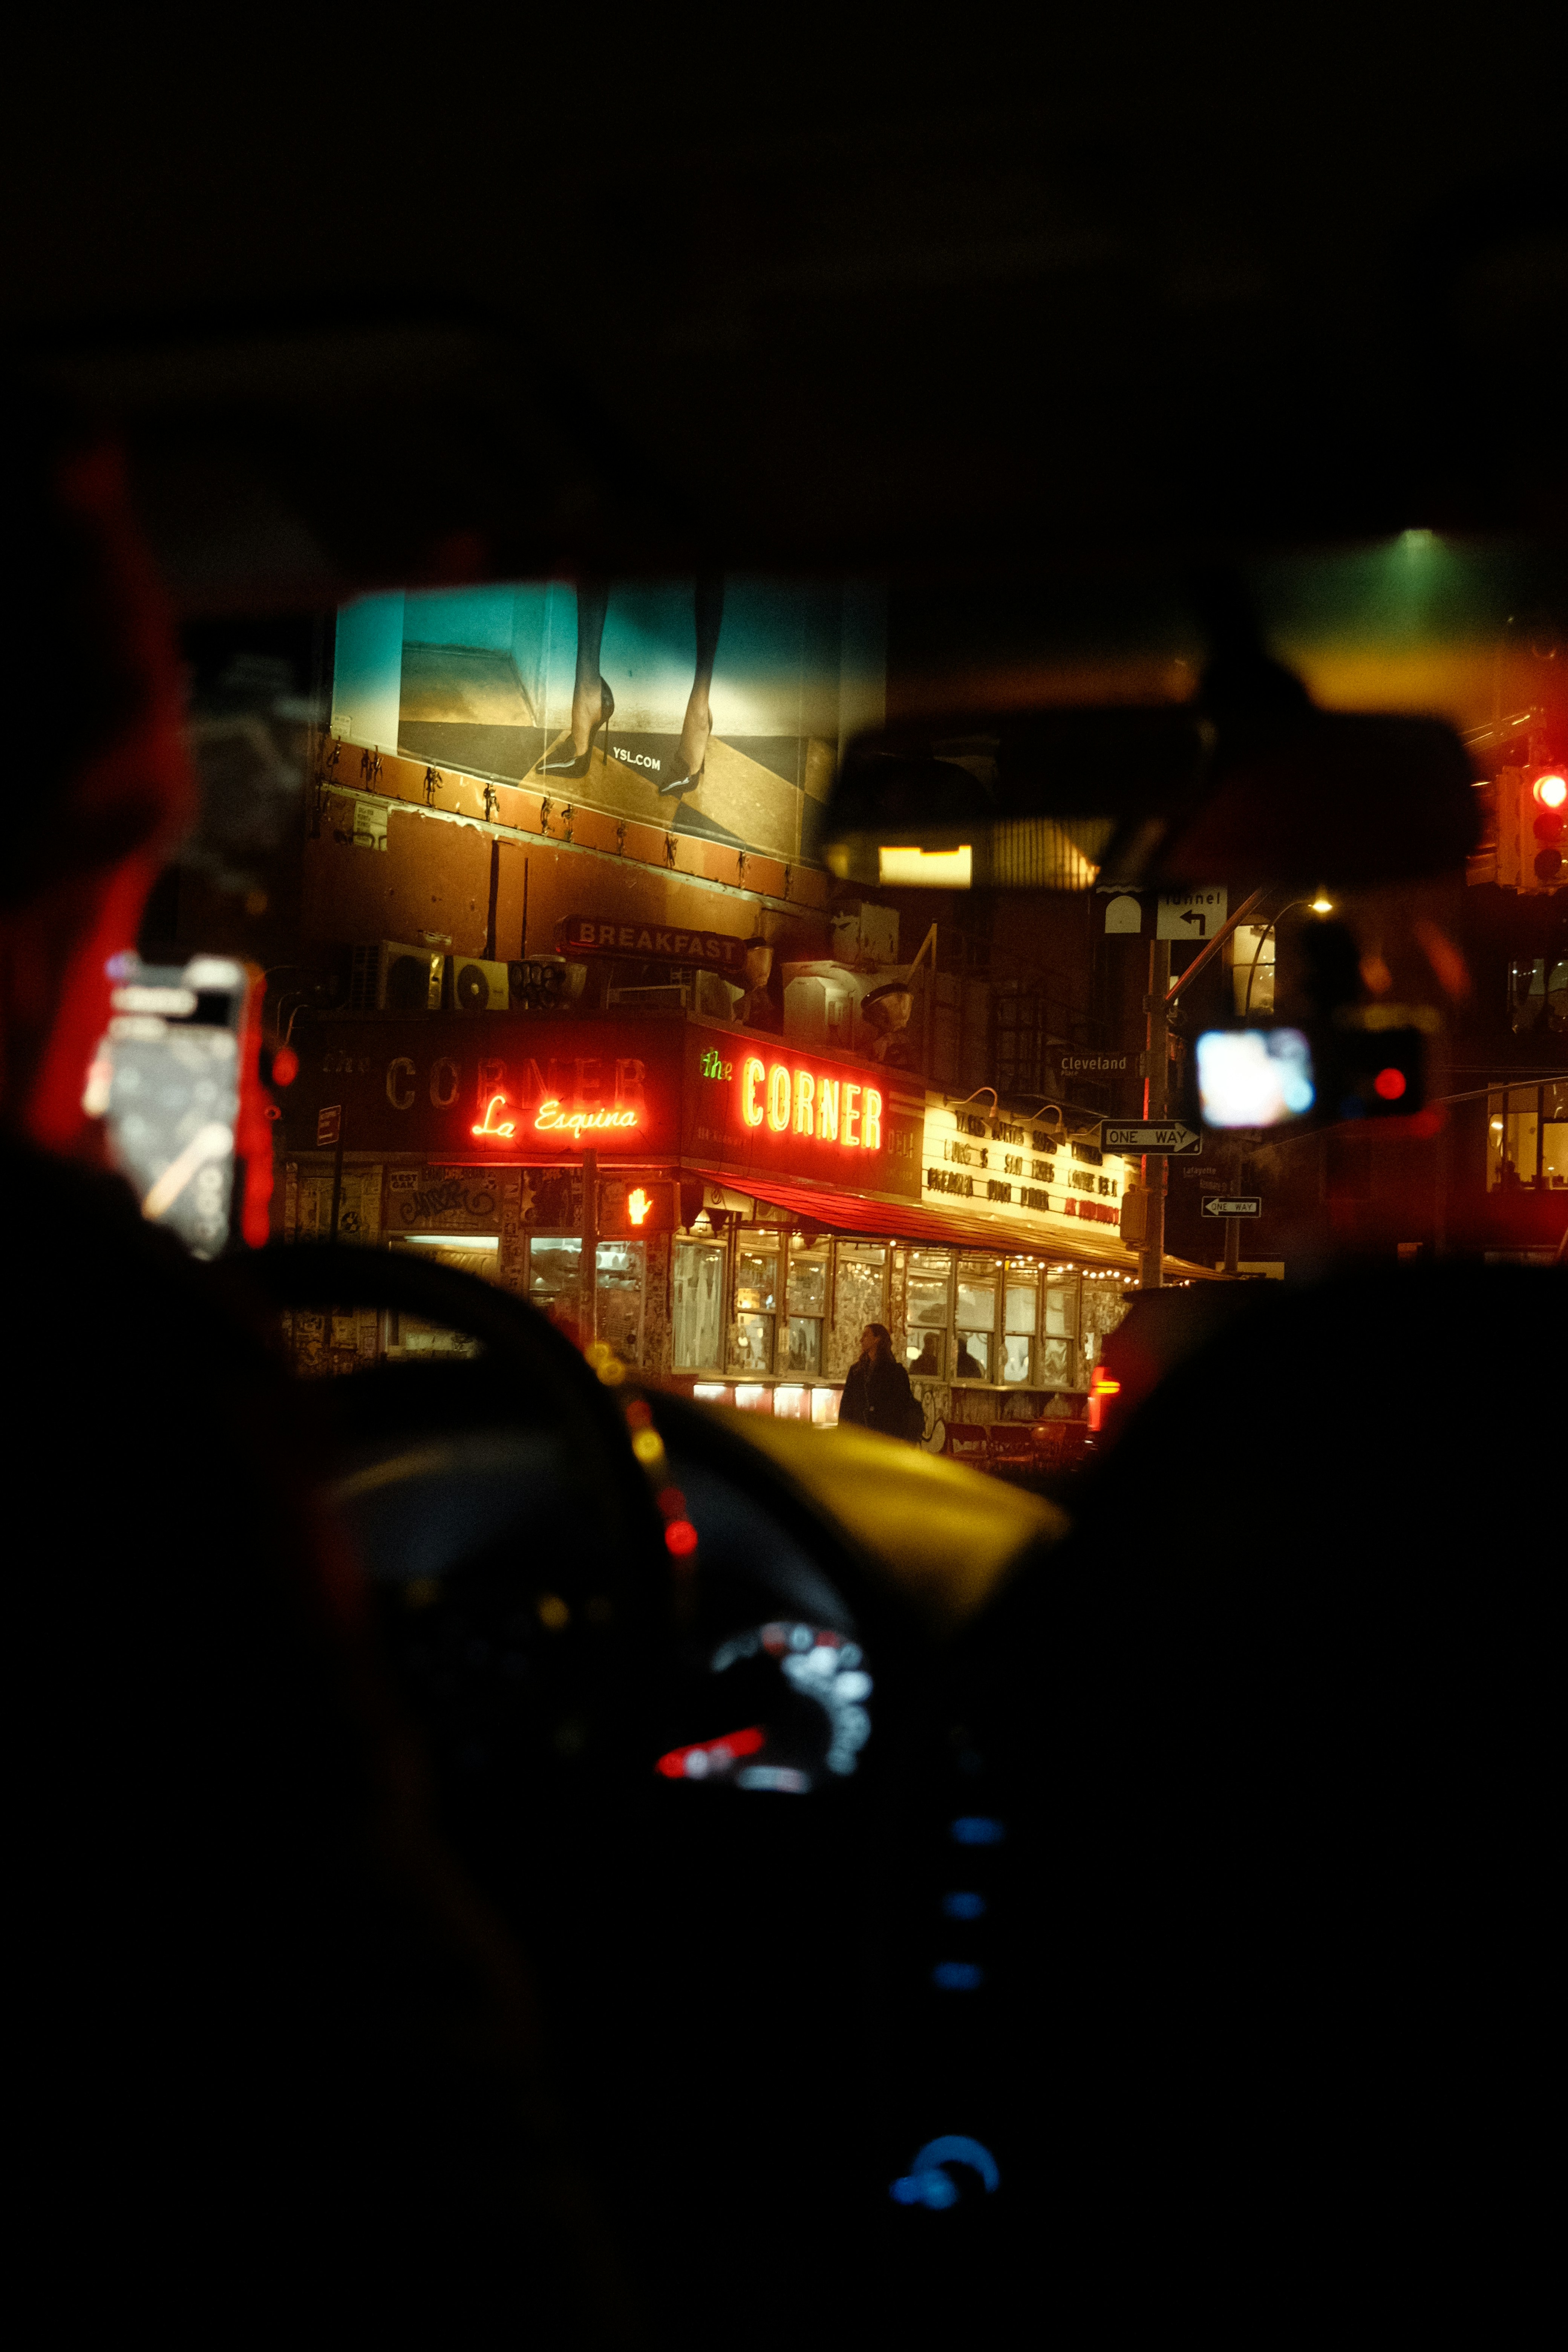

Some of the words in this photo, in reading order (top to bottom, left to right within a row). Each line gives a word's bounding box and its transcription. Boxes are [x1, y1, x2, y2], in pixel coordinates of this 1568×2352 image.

[613, 747, 660, 771] YSL.COM
[579, 922, 736, 961] BREAKFAST
[1061, 1057, 1127, 1070] Cleveland
[386, 1057, 646, 1110] CORNER
[700, 1048, 732, 1081] the
[743, 1057, 882, 1149] CORNER
[472, 1096, 515, 1138] La
[534, 1100, 638, 1139] Esquina
[1110, 1131, 1138, 1143] ONE
[1156, 1131, 1188, 1143] WAY
[1211, 1202, 1228, 1211] ONE
[1235, 1202, 1254, 1211] WAY
